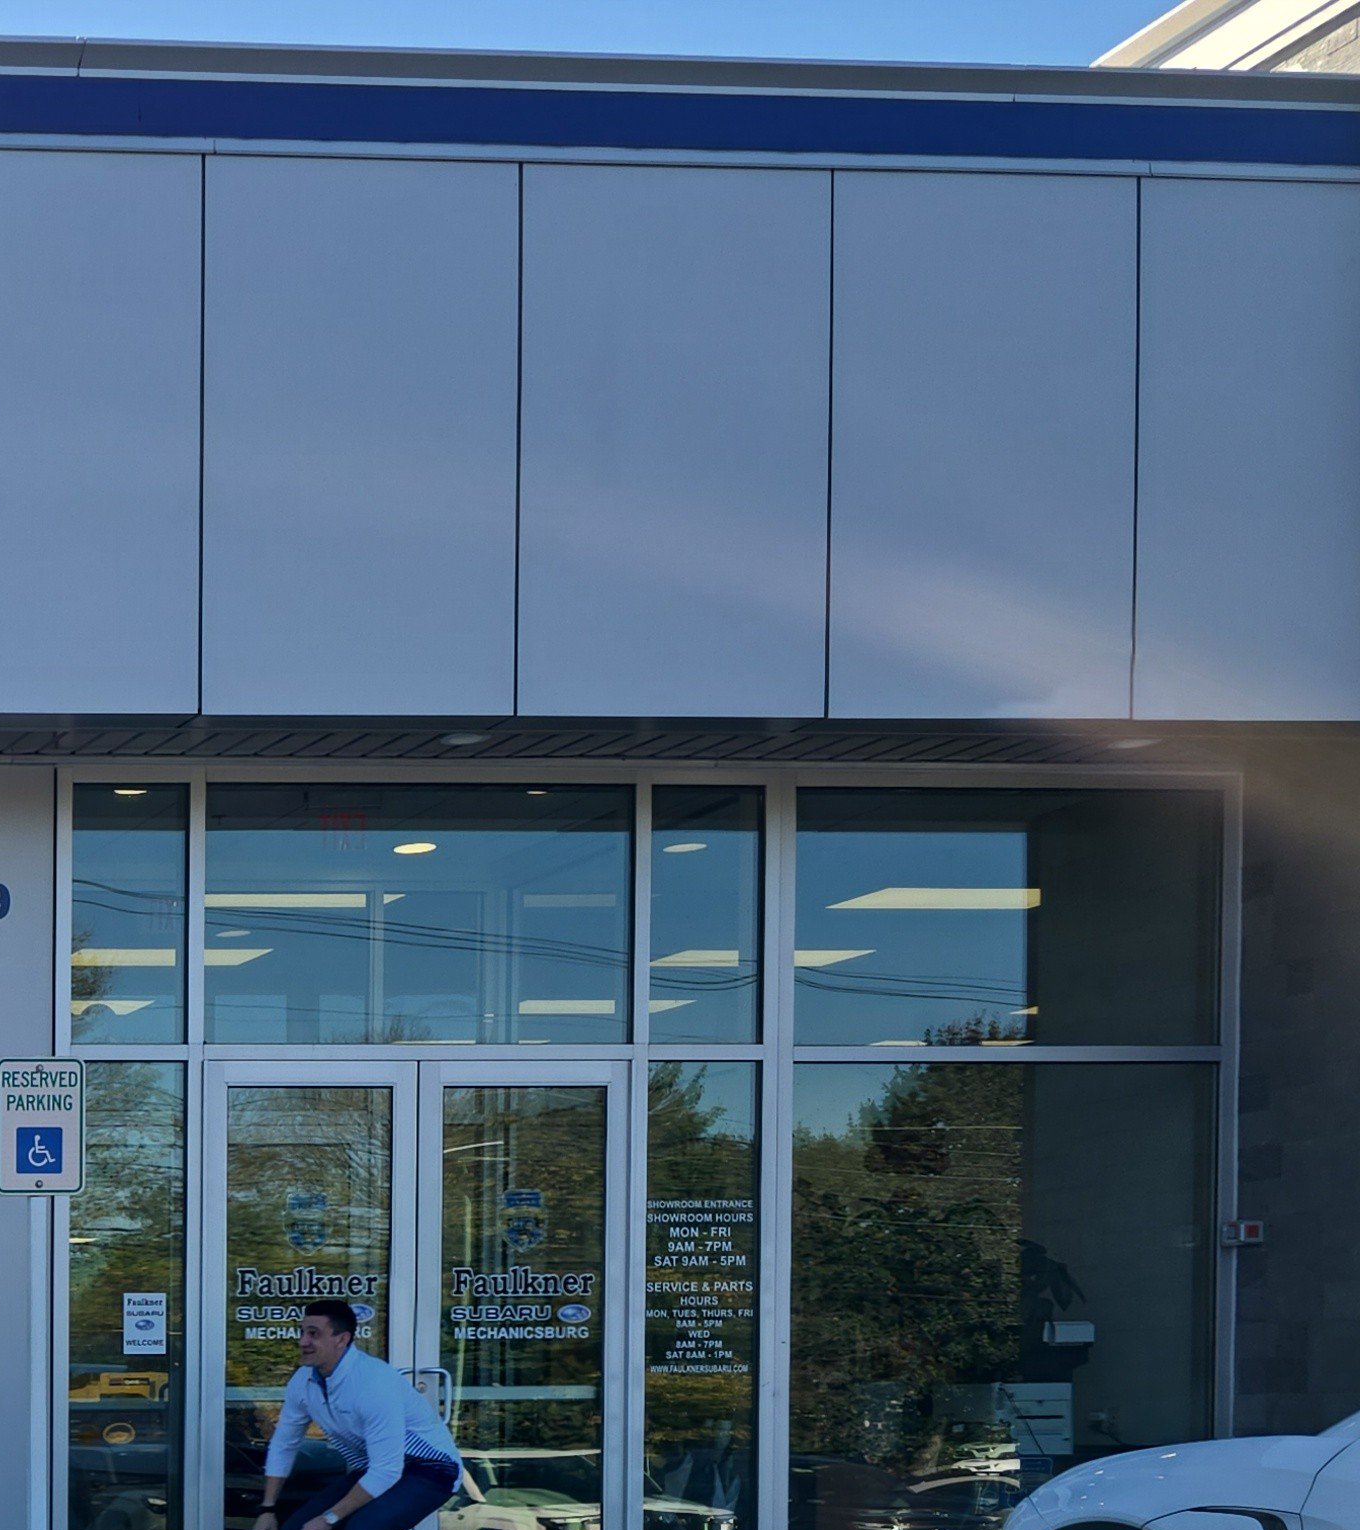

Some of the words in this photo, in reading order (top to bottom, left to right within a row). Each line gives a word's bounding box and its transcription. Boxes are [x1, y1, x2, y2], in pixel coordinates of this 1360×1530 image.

[1, 1071, 78, 1088] RESERVED
[6, 1094, 73, 1111] PARKING
[647, 1200, 702, 1209] SHOWROOM
[704, 1200, 753, 1208] ENTRANCE
[647, 1213, 712, 1223] SHOWROOM
[715, 1213, 753, 1223] HOURS
[669, 1227, 699, 1238] MON
[710, 1227, 731, 1238] FRI
[668, 1241, 695, 1252] 9AM
[705, 1241, 732, 1252] 7PM
[654, 1256, 678, 1266] SAT
[681, 1256, 709, 1266] 9AM
[720, 1256, 746, 1266] 5PM
[237, 1266, 379, 1297] Faulkner
[452, 1266, 595, 1297] Faulkner
[646, 1282, 699, 1292] SERVICE
[701, 1282, 711, 1292] &
[713, 1282, 753, 1292] PARTS
[127, 1298, 163, 1306] Faulkner
[680, 1296, 719, 1305] HOURS
[237, 1305, 306, 1322] SUBA
[451, 1305, 552, 1322] SUBARU
[646, 1310, 670, 1319] MON,
[672, 1310, 699, 1319] TUES,
[701, 1310, 736, 1319] THURS,
[738, 1310, 753, 1318] FRI
[454, 1327, 589, 1340] MECHANICSBURG
[688, 1330, 710, 1338] WED
[666, 1351, 684, 1359] SAT
